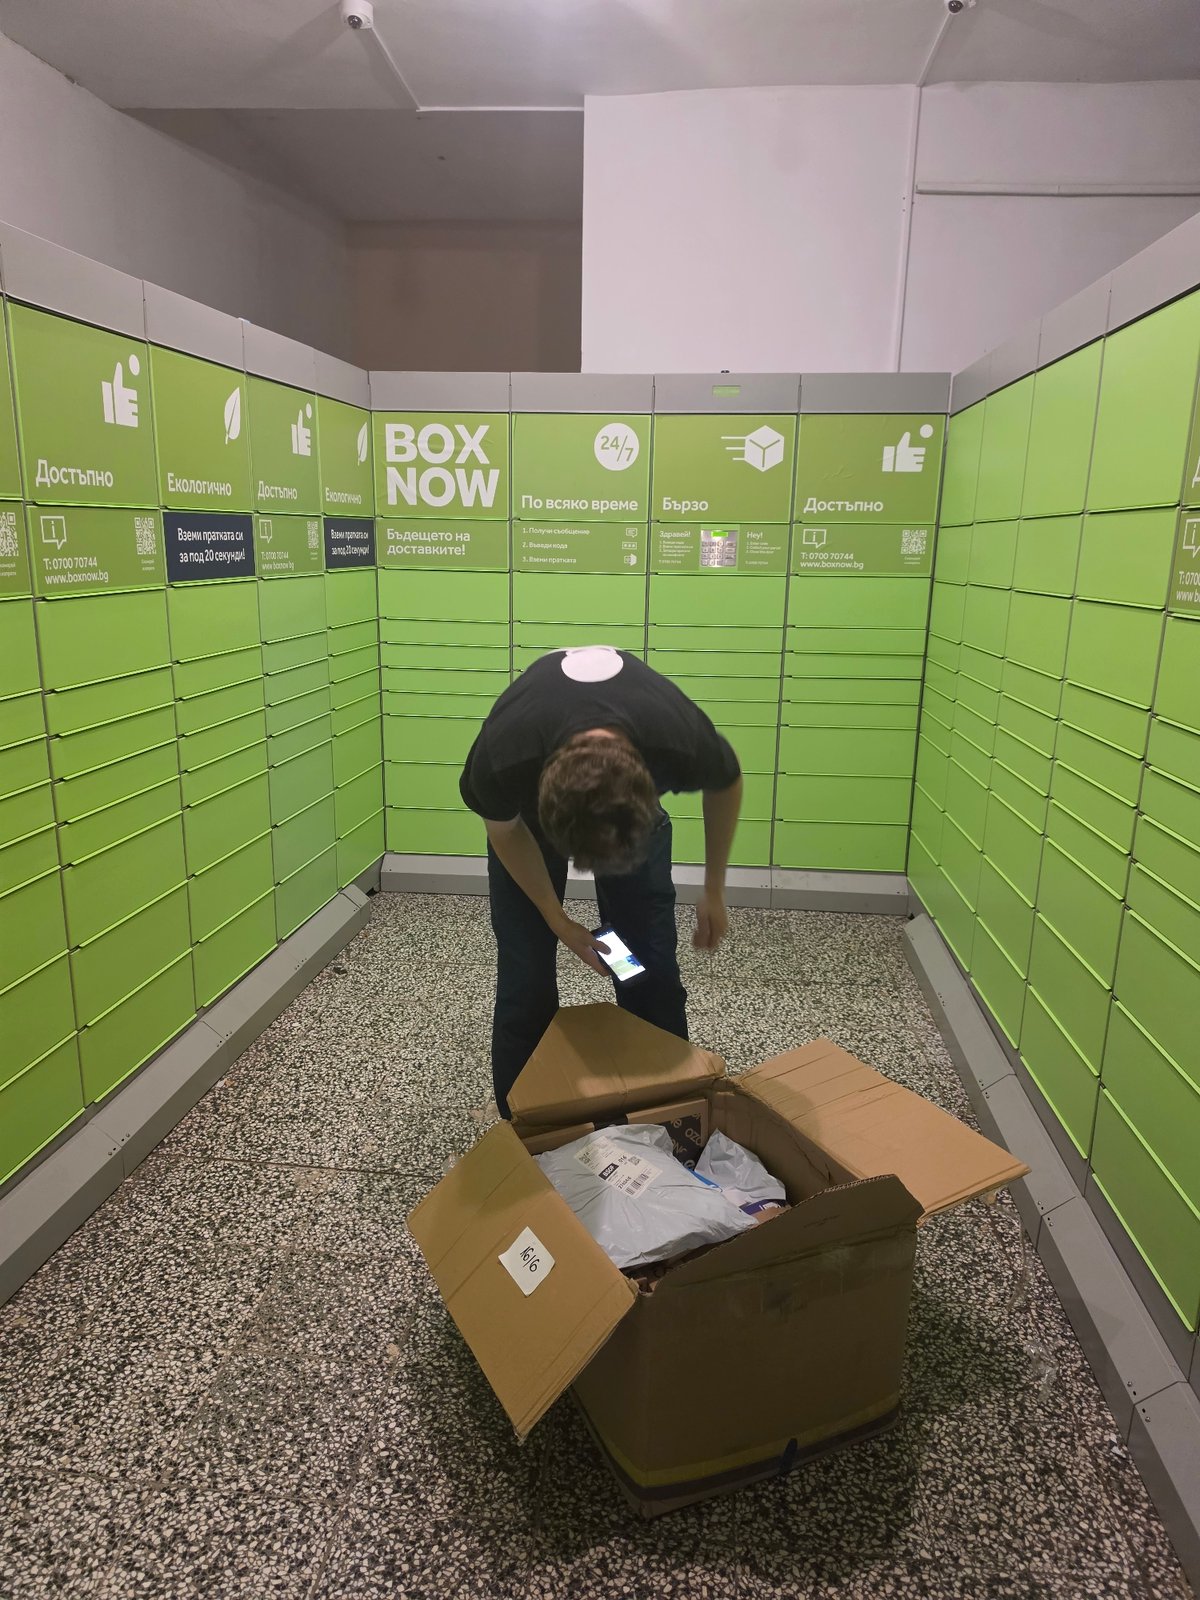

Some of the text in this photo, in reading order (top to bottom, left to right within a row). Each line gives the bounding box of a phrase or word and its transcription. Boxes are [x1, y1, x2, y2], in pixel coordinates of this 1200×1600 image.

[385, 423, 490, 465] BOX
[600, 435, 634, 462] 24/7
[36, 458, 114, 488] Достъпно
[167, 472, 232, 497] Екологично
[257, 480, 298, 501] Достъпно
[386, 467, 500, 508] NOW
[324, 486, 362, 505] Екологично
[521, 495, 639, 514] По всяко време
[662, 496, 709, 514] Бързо
[803, 497, 884, 514] Достъпно
[177, 527, 244, 545] Вземи пратката си
[386, 528, 471, 543] Бъдещето на
[529, 527, 553, 536] Получи
[659, 530, 691, 541] Здравей!
[746, 531, 764, 541] Hey!
[179, 547, 246, 565] за под 20 секунди!
[386, 544, 466, 556] доставките!
[800, 552, 854, 561] T: 0700 70744
[42, 556, 98, 570] T: 0700 70744
[799, 560, 864, 571] www.boxnow.bg
[44, 569, 109, 585] www.boxnow.bg
